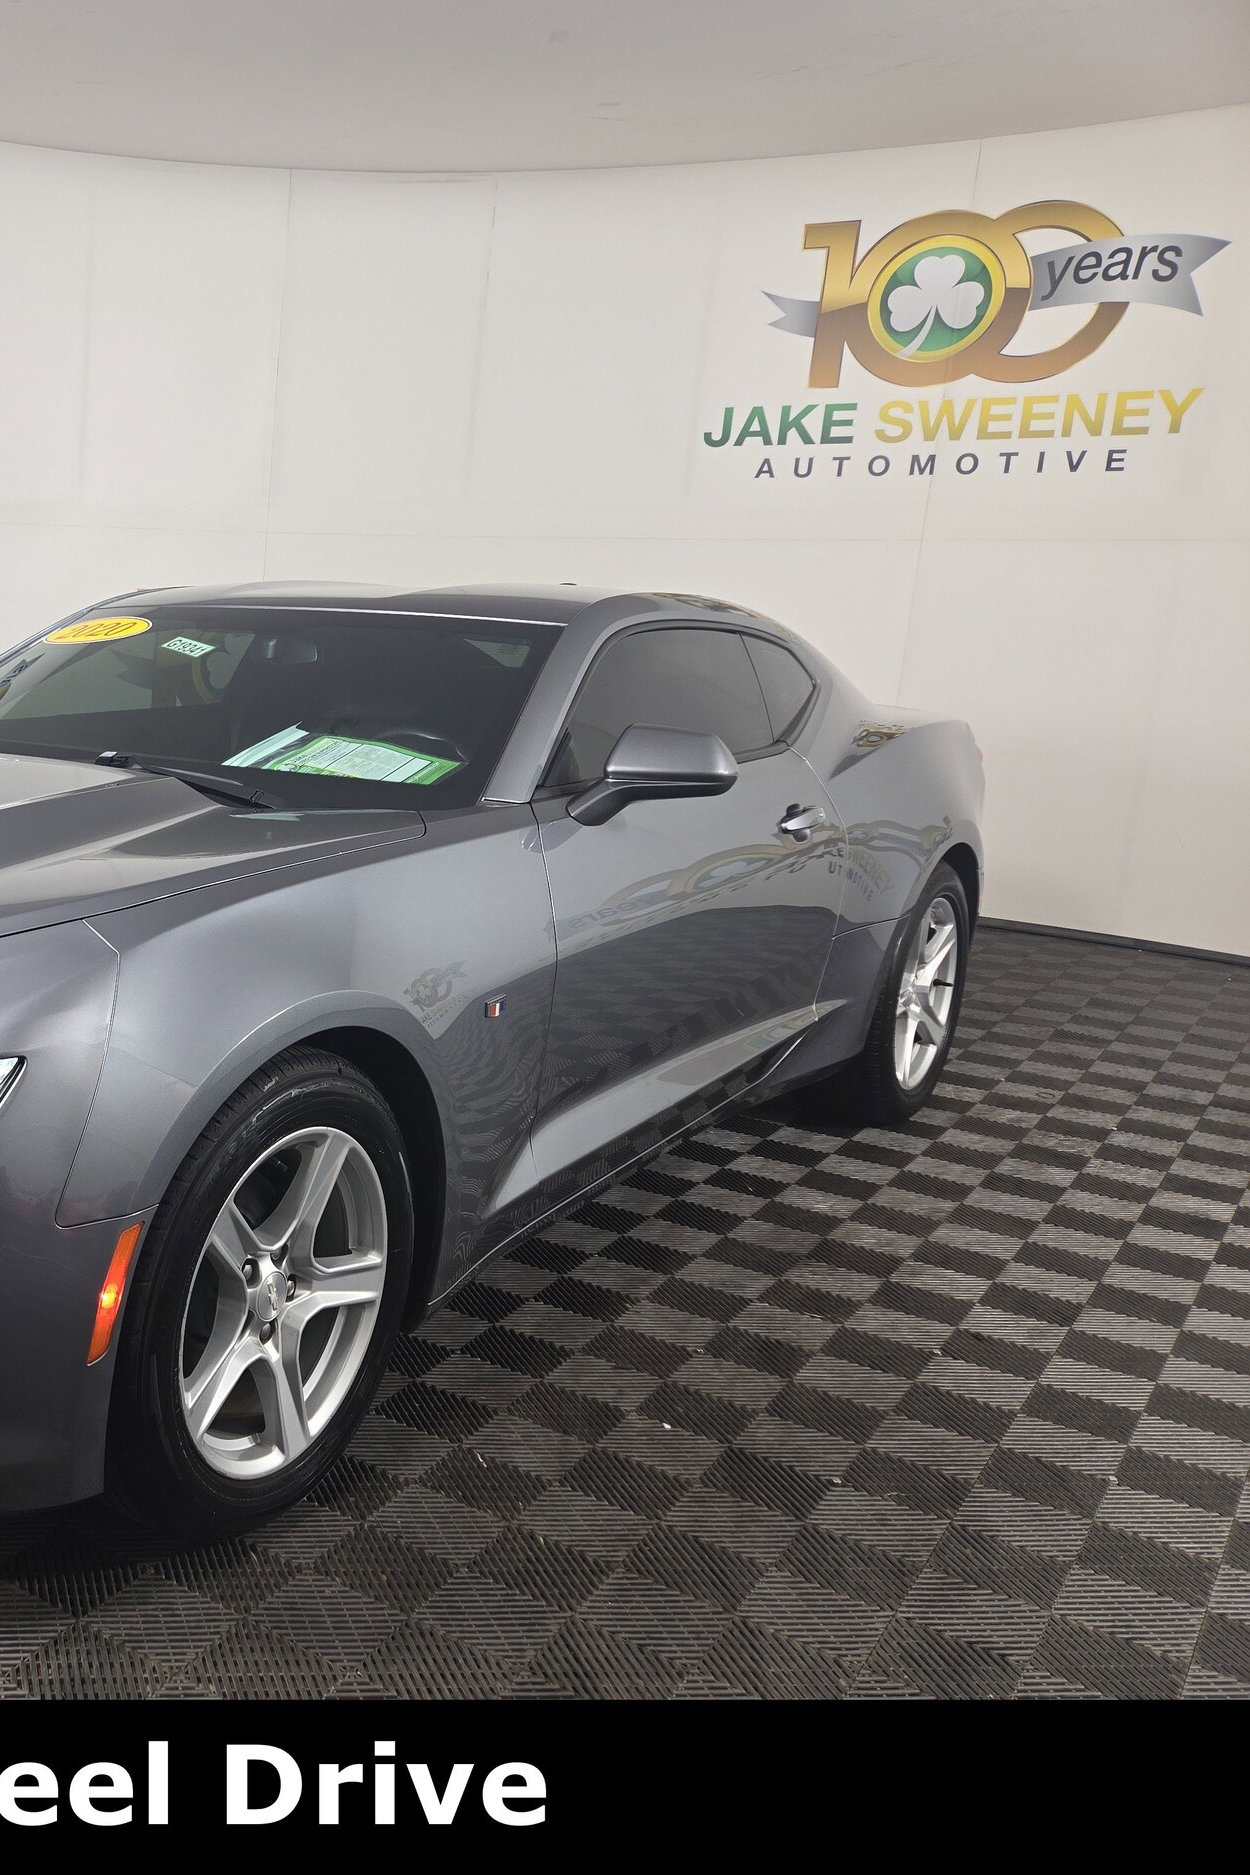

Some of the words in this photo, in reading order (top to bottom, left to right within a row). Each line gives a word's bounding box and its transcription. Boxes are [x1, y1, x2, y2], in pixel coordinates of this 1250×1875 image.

[803, 200, 1128, 389] 100
[1040, 242, 1182, 301] years
[703, 403, 857, 448] JAKE
[875, 388, 1205, 444] SWEENEY
[755, 449, 1127, 479] AUTOMOTIVE
[55, 622, 137, 640] 2020
